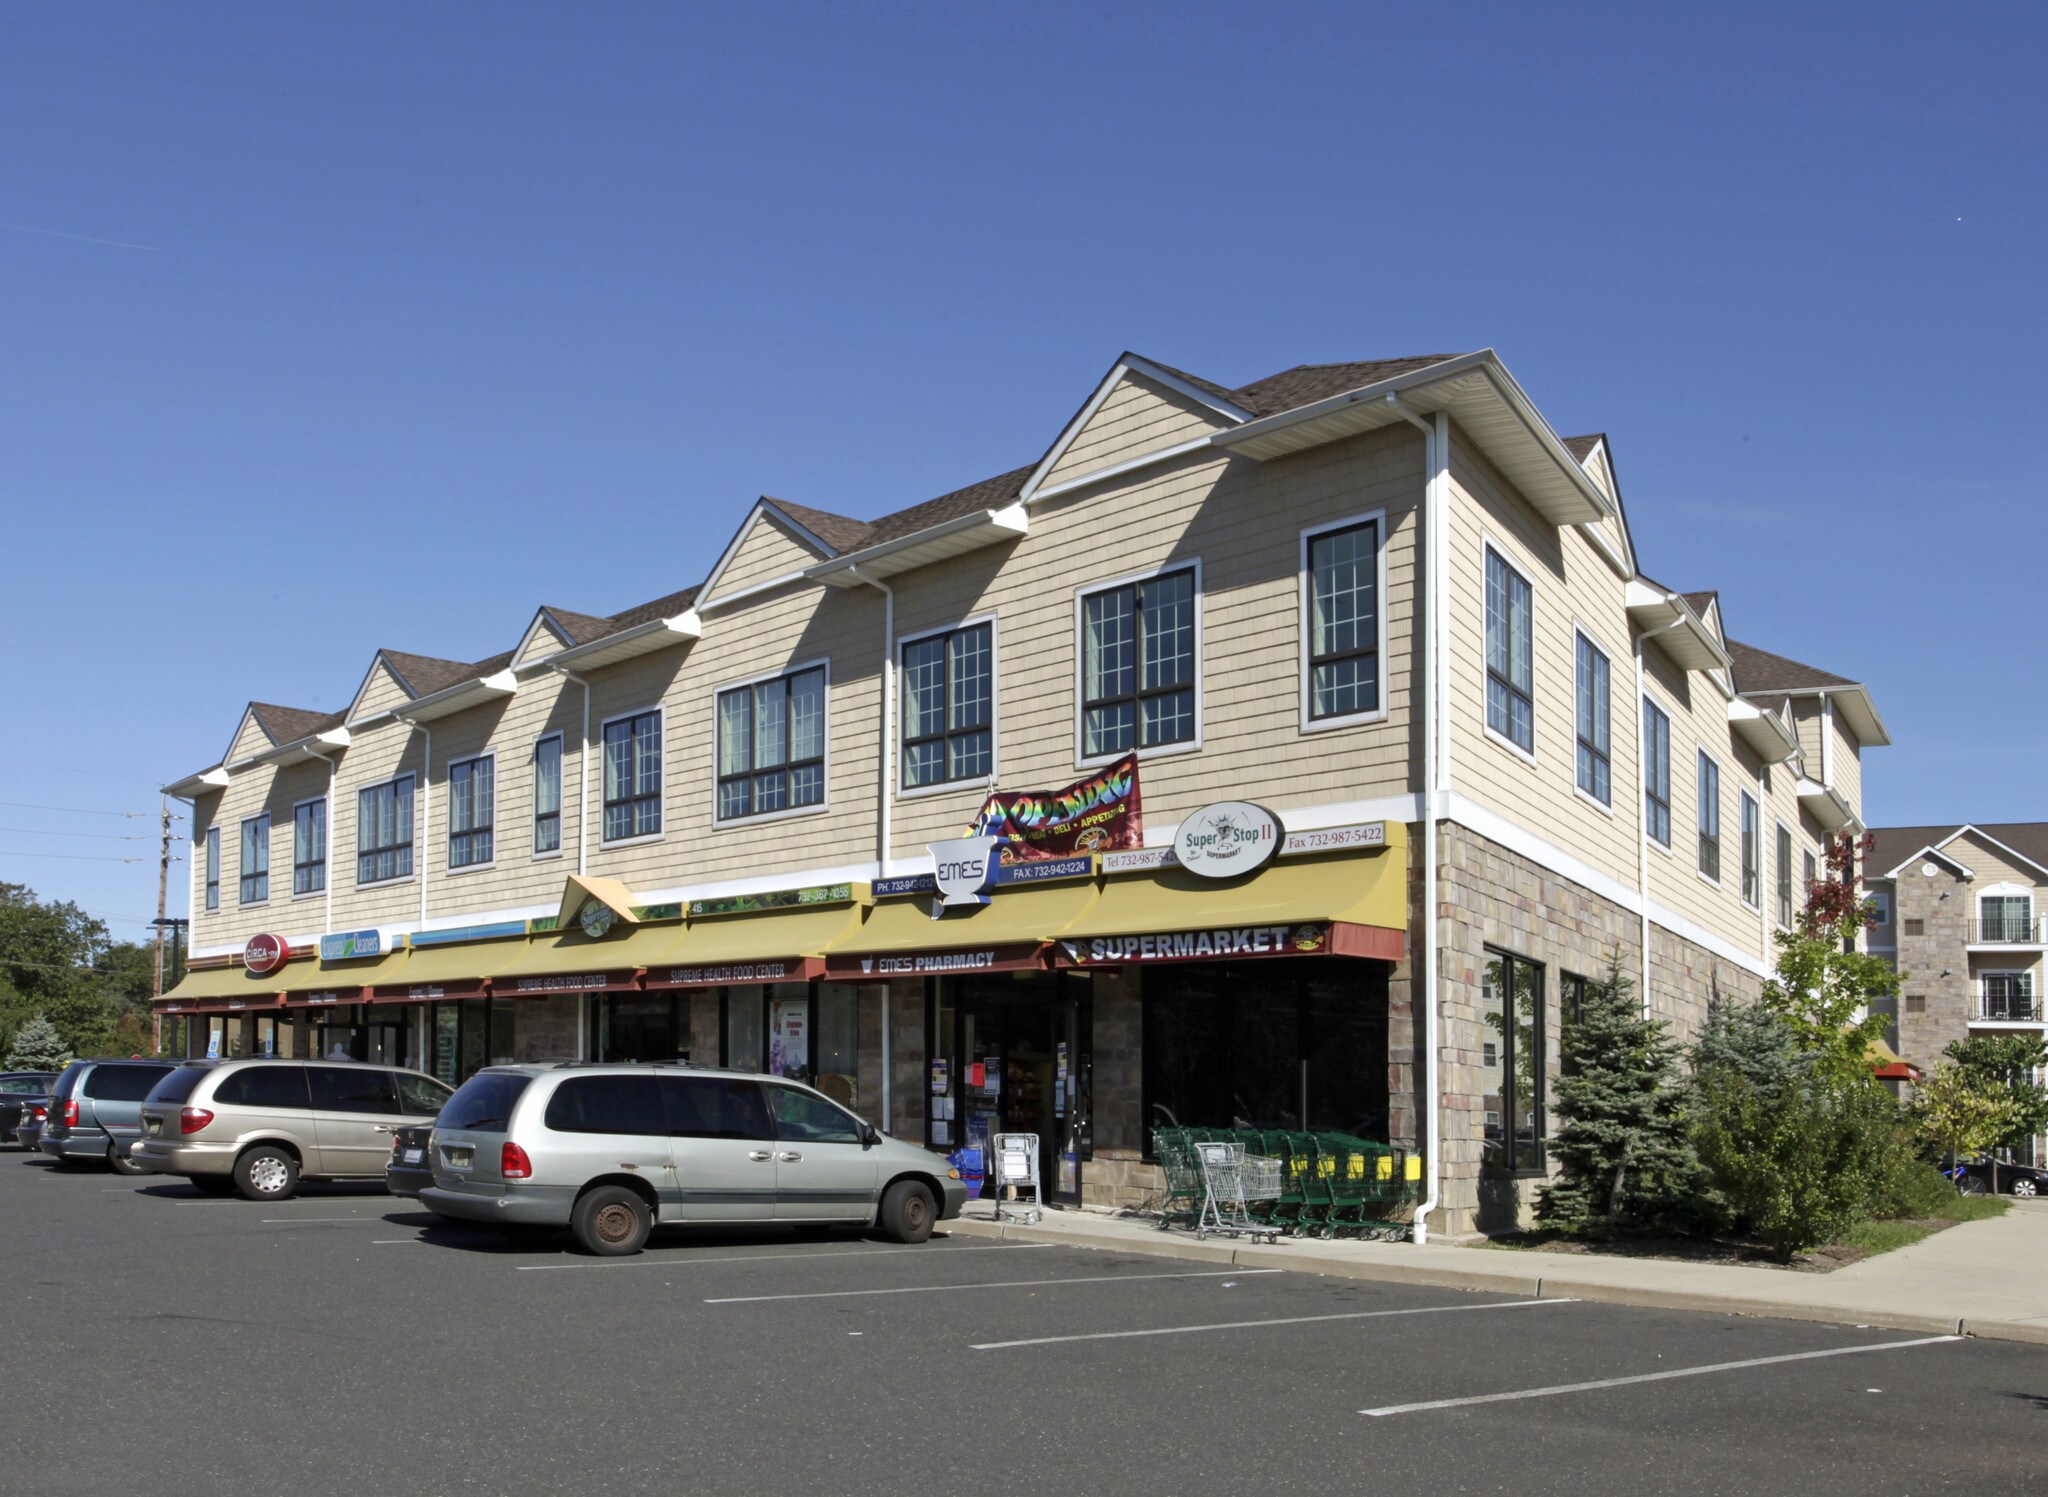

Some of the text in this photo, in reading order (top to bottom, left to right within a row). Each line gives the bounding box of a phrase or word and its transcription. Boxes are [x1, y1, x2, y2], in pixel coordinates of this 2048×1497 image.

[1053, 822, 1071, 835] DELI
[1186, 824, 1272, 849] Super Stop II
[1288, 828, 1382, 849] Fax 732-987-5422
[1106, 856, 1119, 868] Tel
[1206, 847, 1242, 860] SUPERMARKET
[938, 859, 984, 882] EMES
[1013, 861, 1085, 879] FAX: 732-942-1224
[353, 932, 379, 953] Cleaners
[1090, 926, 1290, 961] SUPERMARKET
[879, 951, 995, 973] EMES PHARMACY
[566, 976, 582, 989] FOOD
[583, 975, 606, 988] CENTER
[671, 963, 785, 983] SUPREME HEALTH FOOD CENTER
